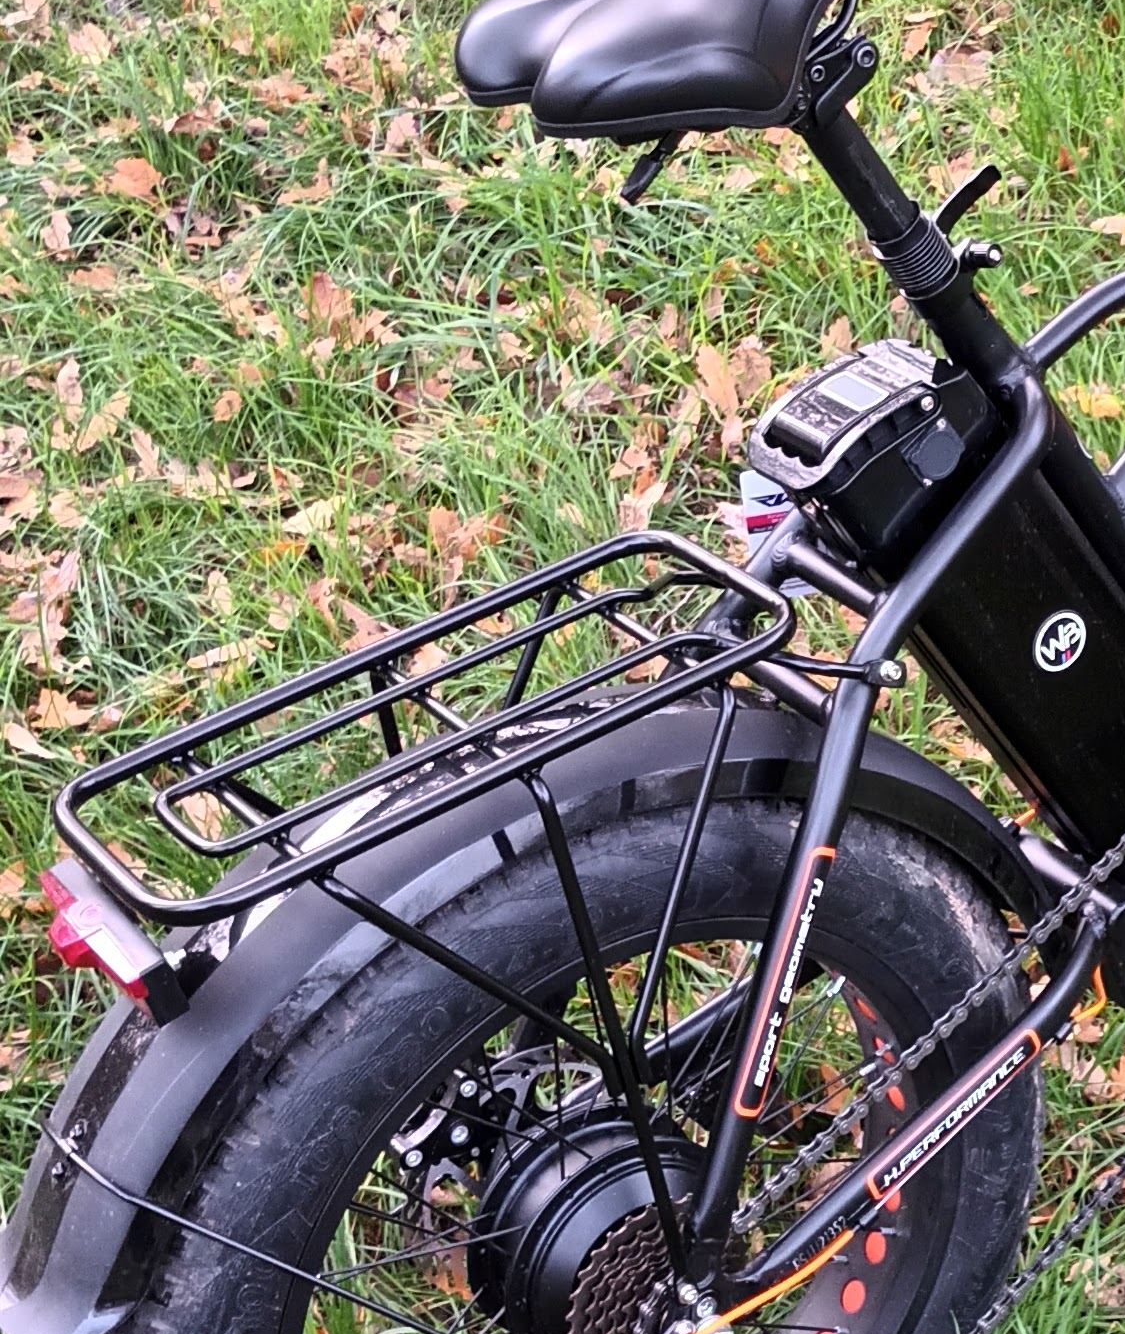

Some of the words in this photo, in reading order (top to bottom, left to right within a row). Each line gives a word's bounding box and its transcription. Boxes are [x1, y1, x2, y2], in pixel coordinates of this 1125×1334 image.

[752, 1013, 781, 1089] sport
[779, 878, 825, 1005] geometry
[881, 1045, 1027, 1188] H.PERFORMANCE
